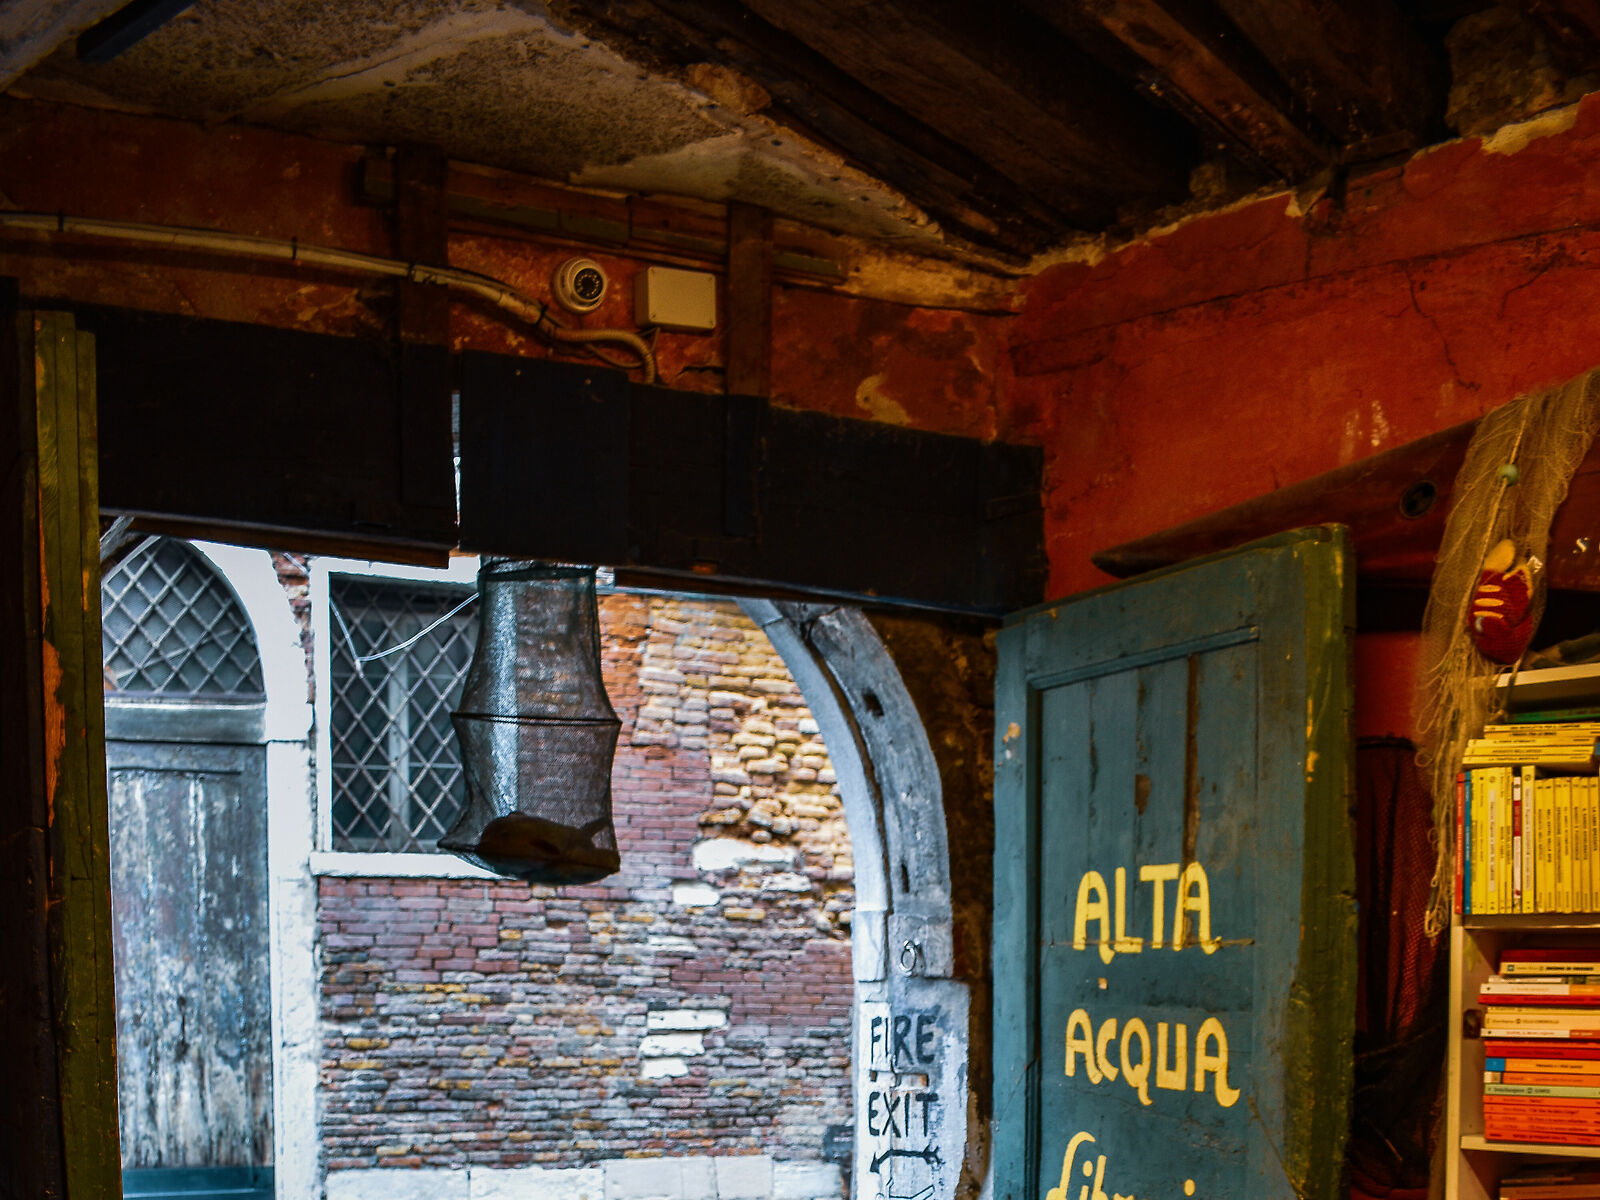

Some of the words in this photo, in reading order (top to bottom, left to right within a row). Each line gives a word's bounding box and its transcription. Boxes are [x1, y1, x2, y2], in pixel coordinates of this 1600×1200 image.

[1072, 861, 1223, 965] ALTA
[871, 1015, 937, 1067] FIRE
[1065, 1008, 1241, 1108] ACQUA
[869, 1091, 939, 1138] EXIT
